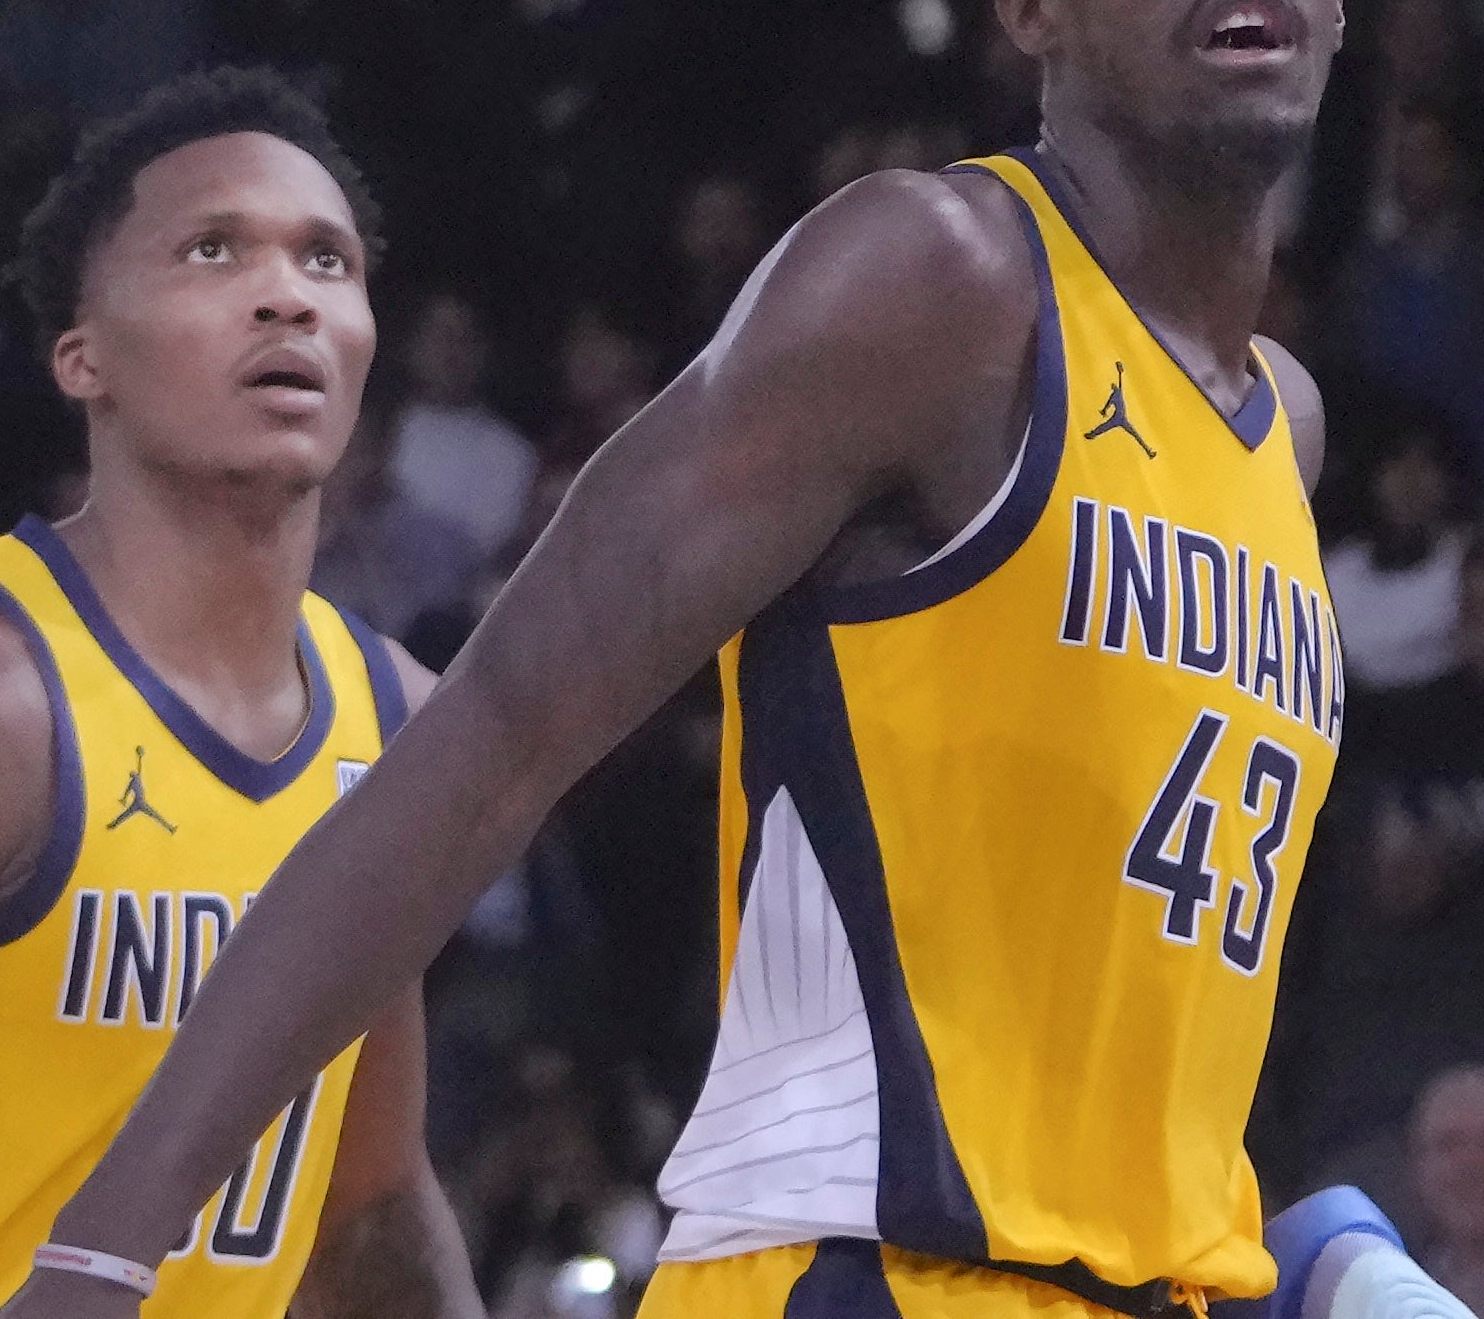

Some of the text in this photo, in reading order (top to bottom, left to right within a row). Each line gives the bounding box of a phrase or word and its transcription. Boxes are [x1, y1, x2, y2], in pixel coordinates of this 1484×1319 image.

[1057, 495, 1344, 753] INDIANA
[1121, 707, 1302, 977] 43
[166, 1072, 324, 1266] 0
